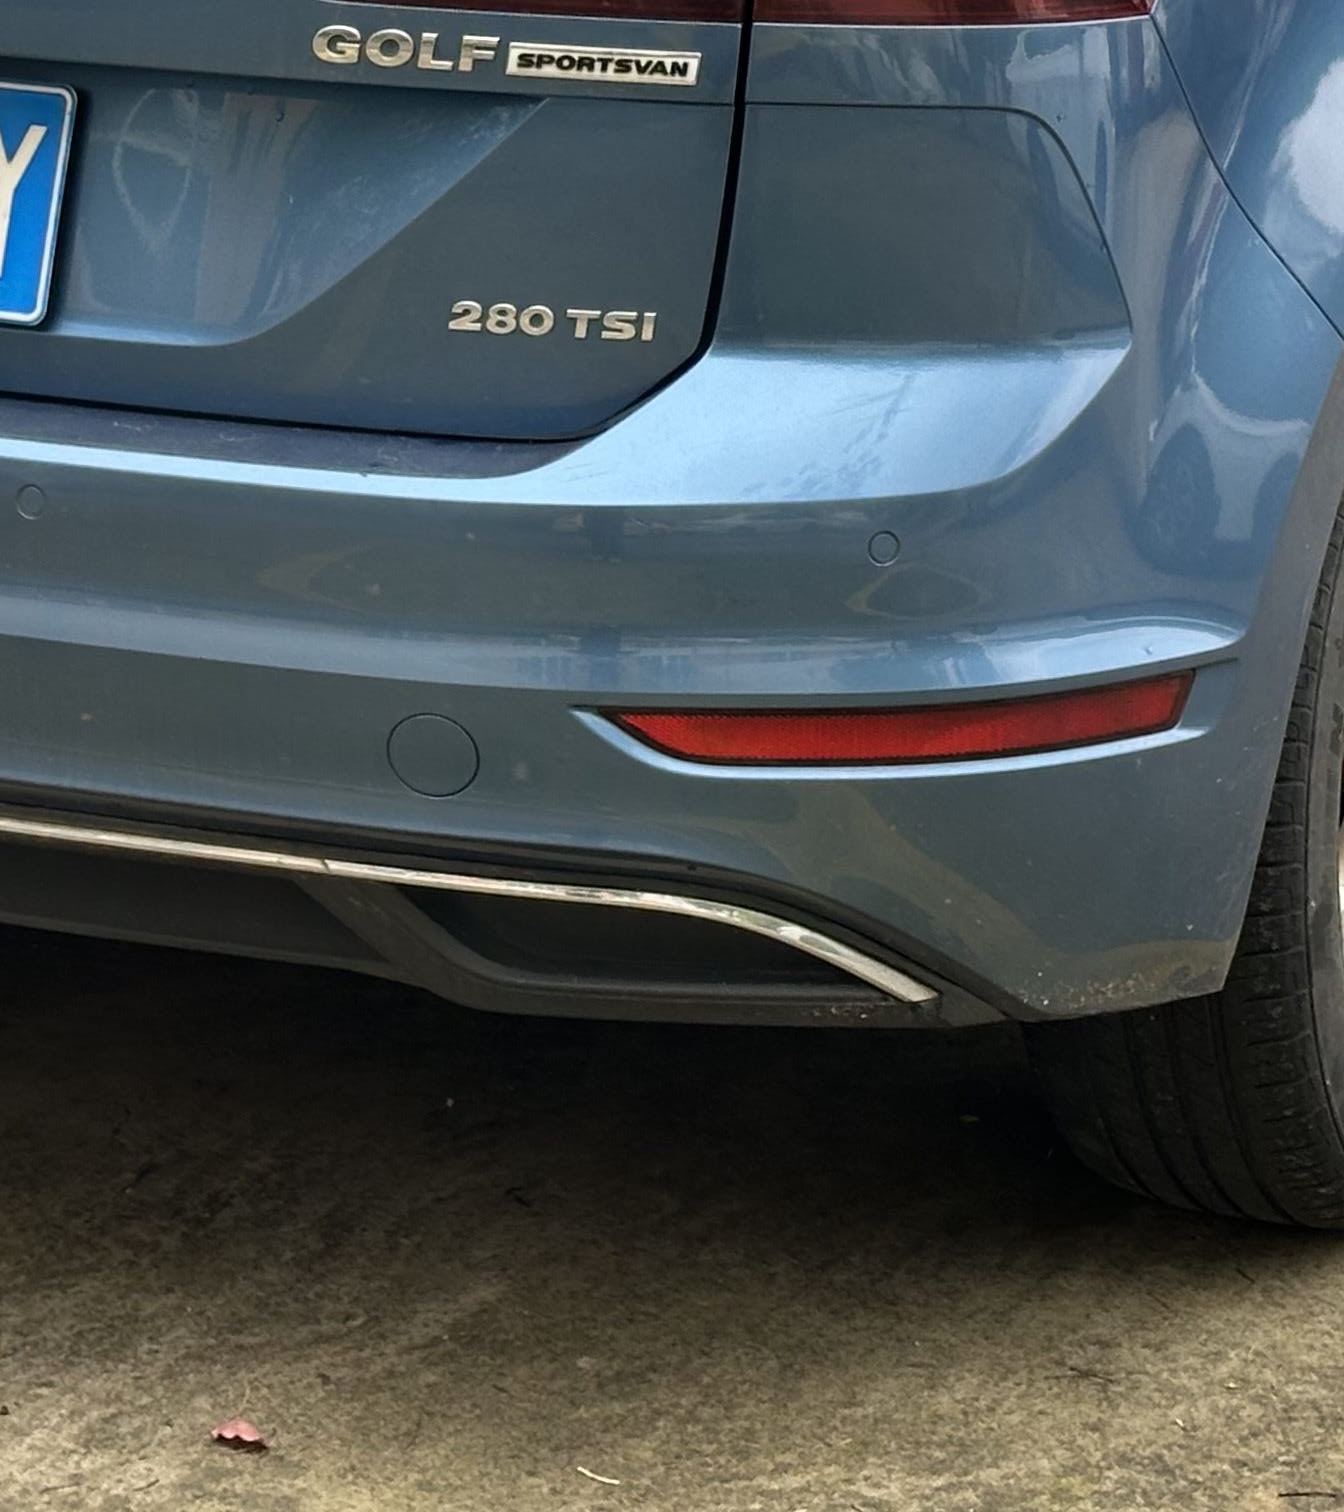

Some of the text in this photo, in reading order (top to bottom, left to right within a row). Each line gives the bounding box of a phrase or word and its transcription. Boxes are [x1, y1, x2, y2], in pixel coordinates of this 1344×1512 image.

[311, 24, 690, 78] GOLF SPORTSVAN
[447, 299, 657, 342] 280 TSI
